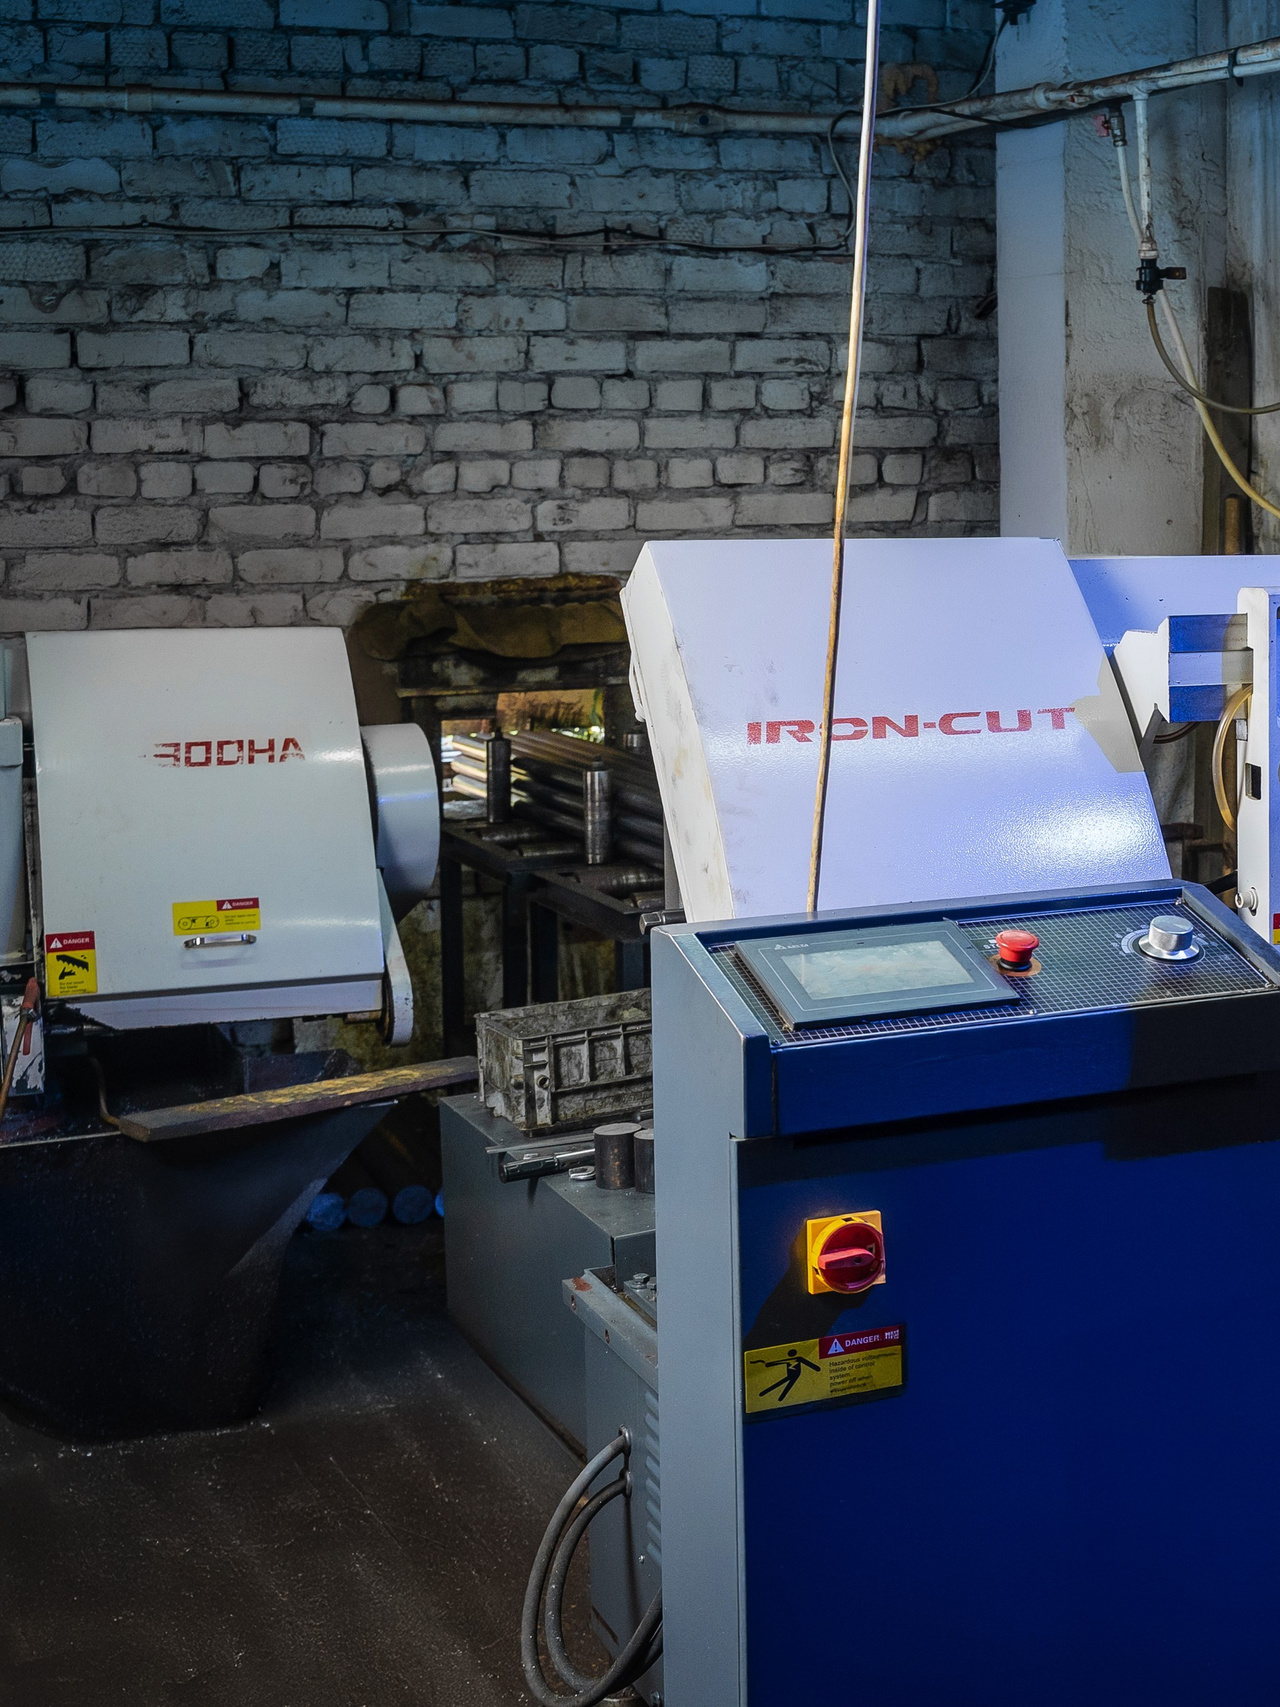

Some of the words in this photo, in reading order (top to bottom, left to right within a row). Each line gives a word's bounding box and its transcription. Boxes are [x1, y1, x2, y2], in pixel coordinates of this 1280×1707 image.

[747, 707, 1076, 746] IRON-CUT
[62, 937, 90, 945] DANGER
[845, 1334, 880, 1347] DANGER
